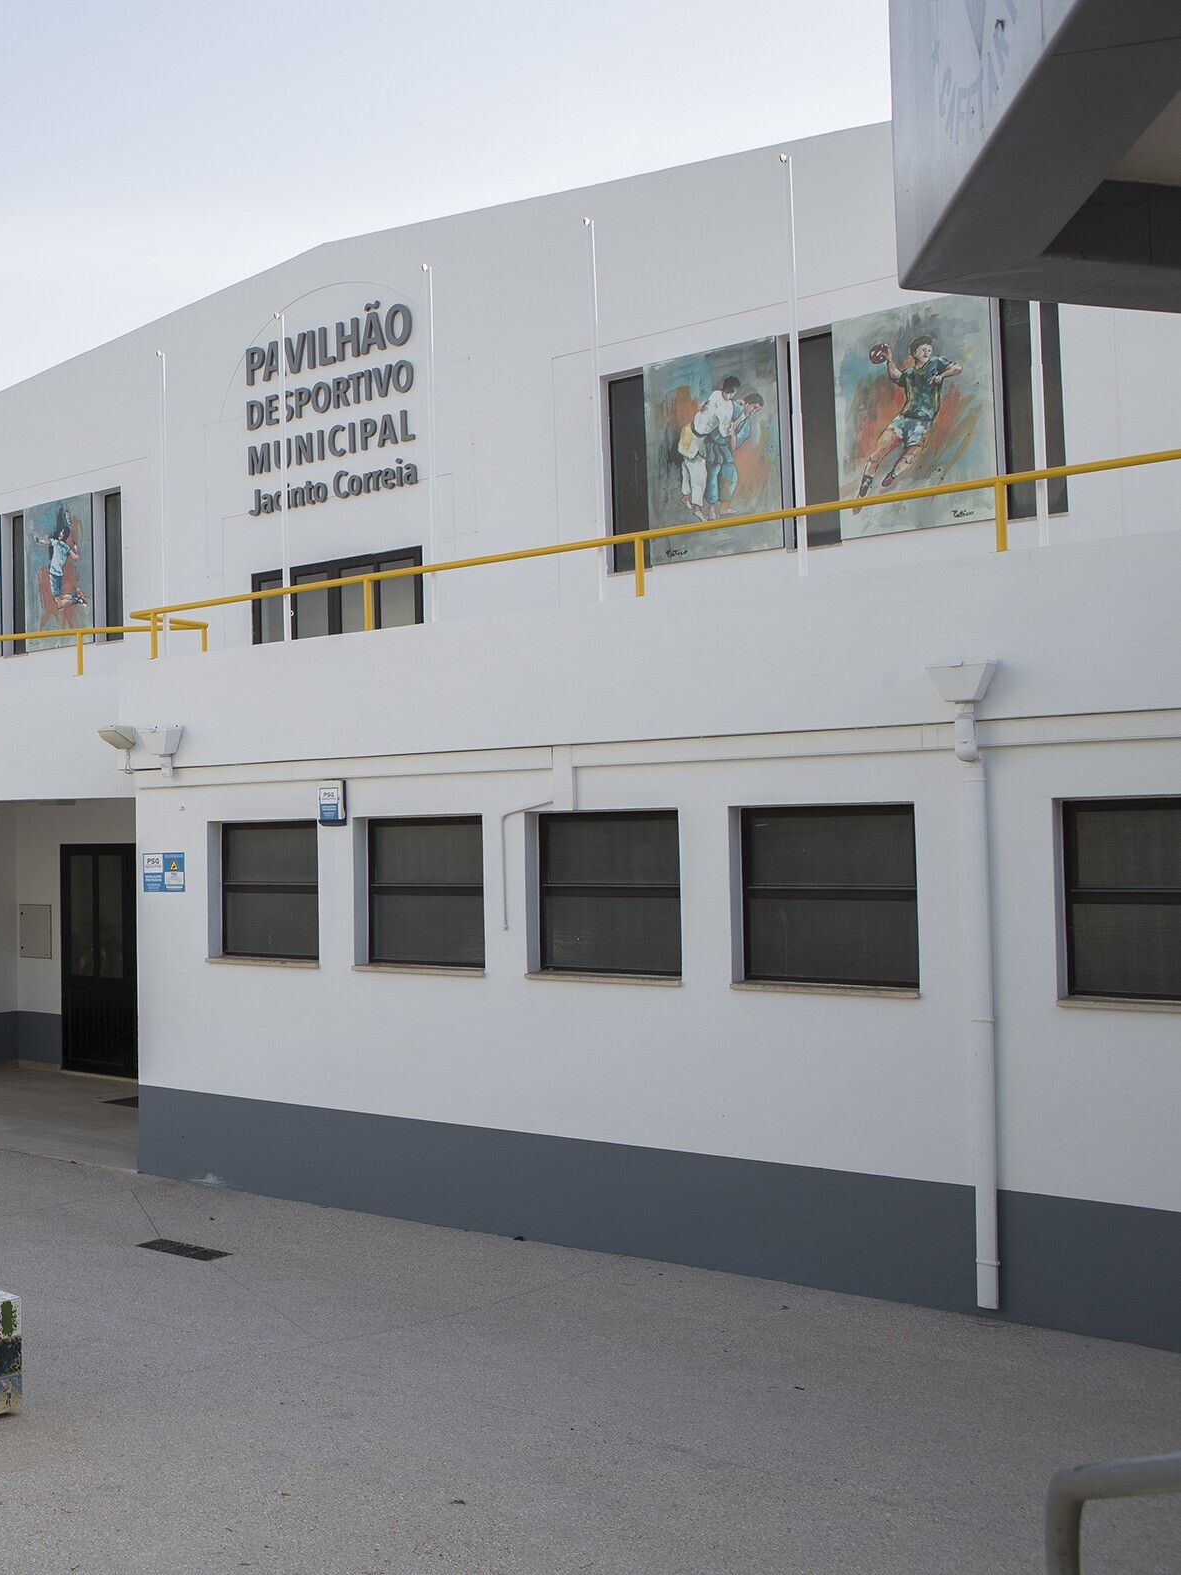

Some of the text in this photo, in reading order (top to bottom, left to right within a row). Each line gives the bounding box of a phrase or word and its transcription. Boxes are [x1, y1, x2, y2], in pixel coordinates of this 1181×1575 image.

[246, 300, 412, 386] PAVILHÃO
[246, 359, 414, 431] DESPORTIVO
[248, 409, 416, 476] MUNICIPAL
[249, 458, 418, 517] Jacinto Correia
